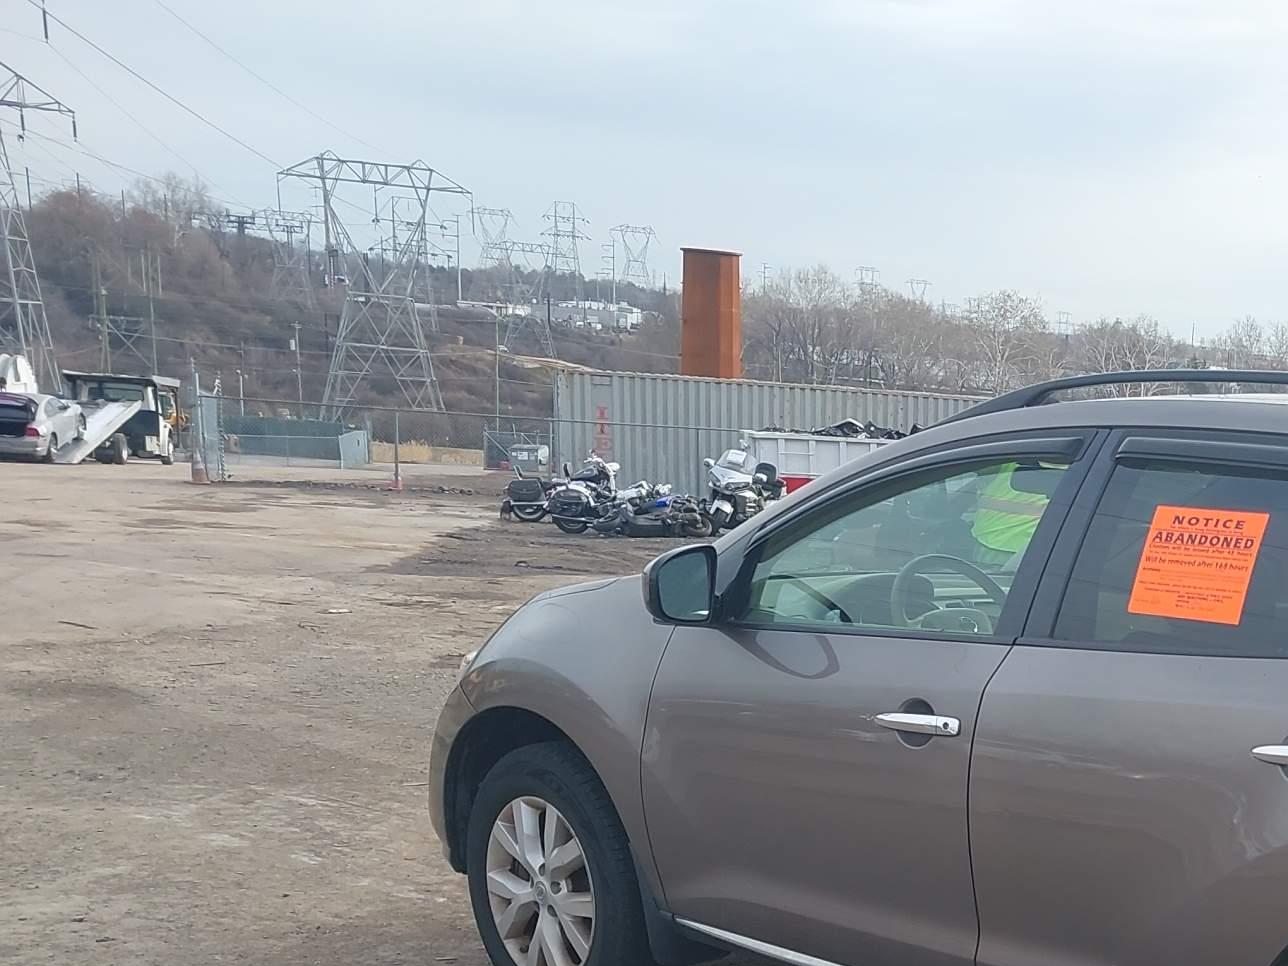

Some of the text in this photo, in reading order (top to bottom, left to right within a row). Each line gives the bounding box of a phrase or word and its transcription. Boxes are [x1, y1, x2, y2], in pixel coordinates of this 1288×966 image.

[1172, 515, 1246, 530] NOTICE
[1152, 531, 1255, 549] ABANDONED
[1159, 556, 1167, 564] be
[1168, 559, 1197, 567] removed
[1197, 560, 1213, 568] after
[1228, 562, 1249, 572] hours
